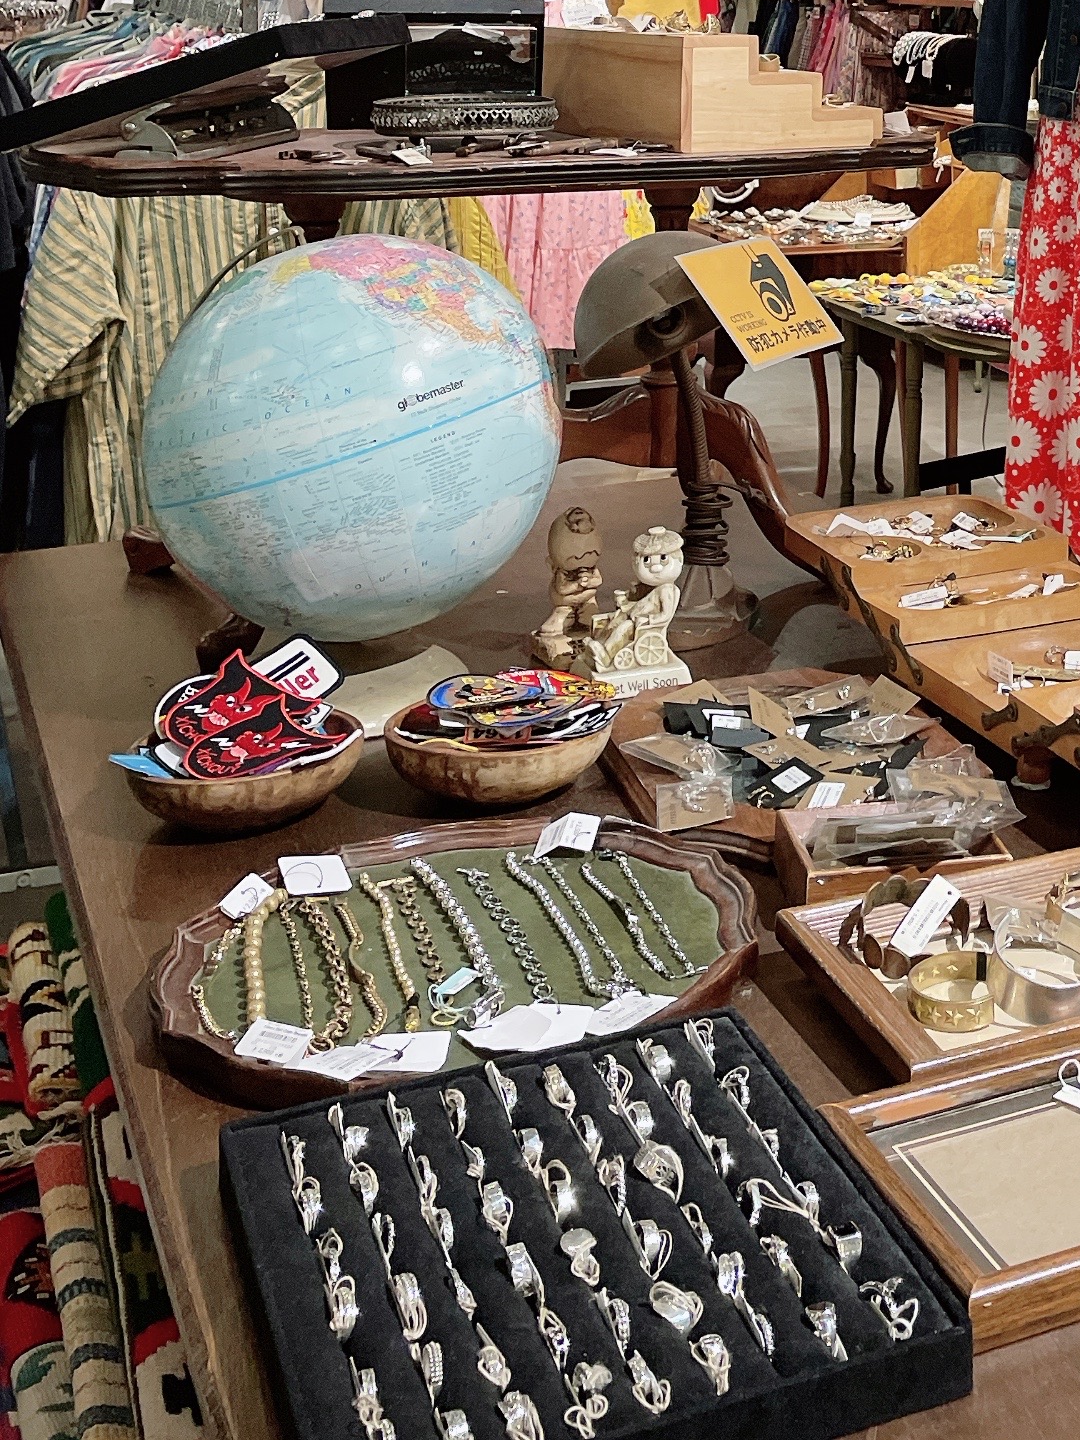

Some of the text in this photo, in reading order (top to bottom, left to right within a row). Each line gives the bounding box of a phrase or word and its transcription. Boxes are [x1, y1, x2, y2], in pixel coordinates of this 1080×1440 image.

[730, 312, 748, 324] CCTV
[737, 318, 768, 333] WORKING
[746, 317, 827, 353] 防犯カメラ作動中
[397, 379, 464, 412] globemaster
[628, 679, 649, 691] Well
[652, 677, 679, 689] Soon
[472, 728, 524, 740] 164
